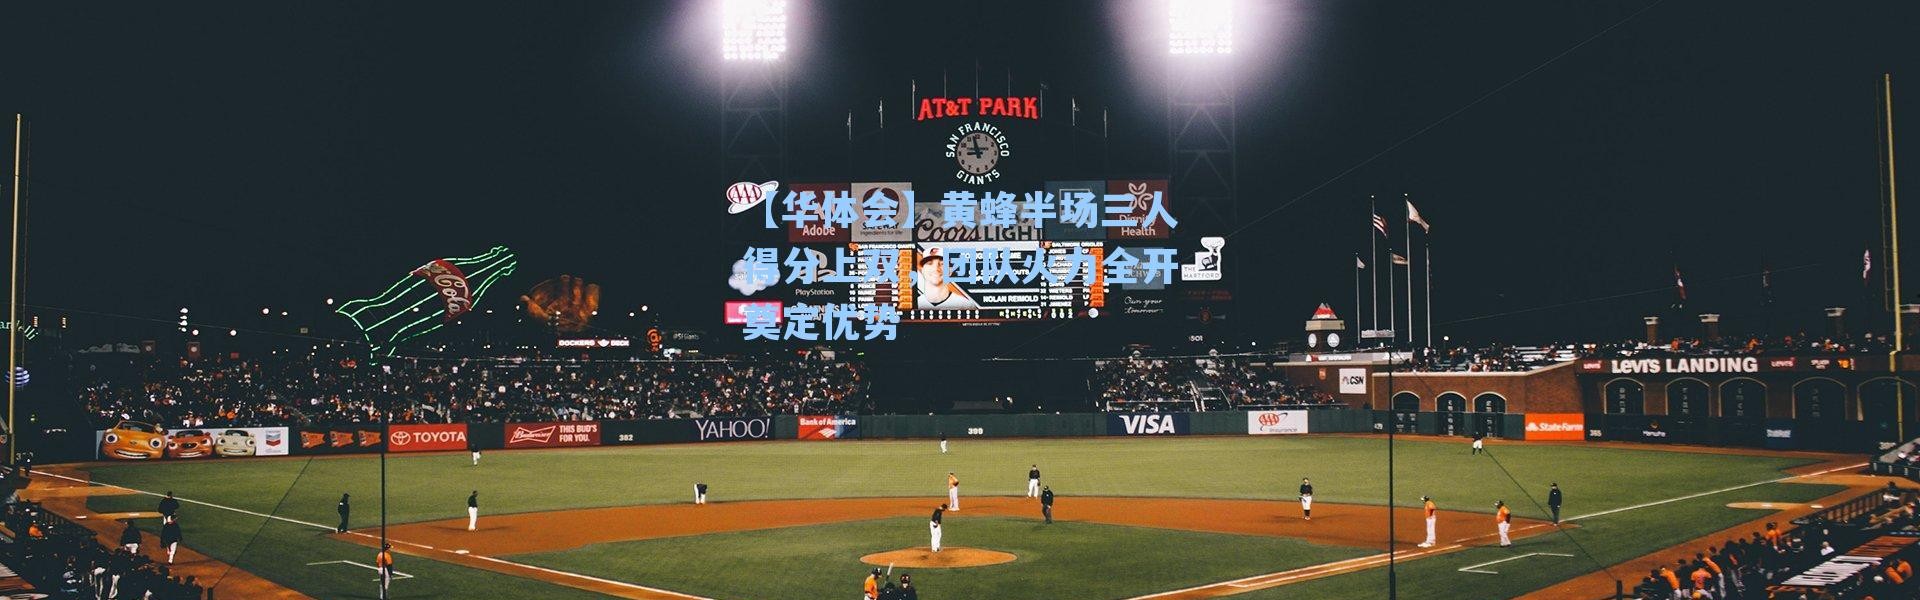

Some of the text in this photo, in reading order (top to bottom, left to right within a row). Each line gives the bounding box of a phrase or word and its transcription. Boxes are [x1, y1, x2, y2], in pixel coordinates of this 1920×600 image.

[918, 97, 1039, 121] AT&T PARK
[946, 121, 1010, 158] SAN FRANCISCO
[956, 168, 1001, 185] GIANTS
[803, 223, 837, 237] Adobe
[917, 219, 982, 241] Coors
[1121, 226, 1156, 236] Health
[795, 289, 835, 298] PlayStation
[983, 295, 1039, 303] NOLAN REIMOLD
[558, 339, 630, 347] DOCKERS DECK
[1666, 357, 1759, 373] LANDING
[1350, 376, 1364, 385] CSN
[800, 418, 817, 426] Bank
[826, 418, 856, 426] America
[1119, 414, 1176, 434] VISA
[514, 430, 553, 440] Budweiser
[559, 425, 598, 434] THIS BUD'S
[695, 418, 770, 441] YAHOO!
[413, 431, 466, 444] TOYOTA
[559, 434, 590, 442] FOR YOU.
